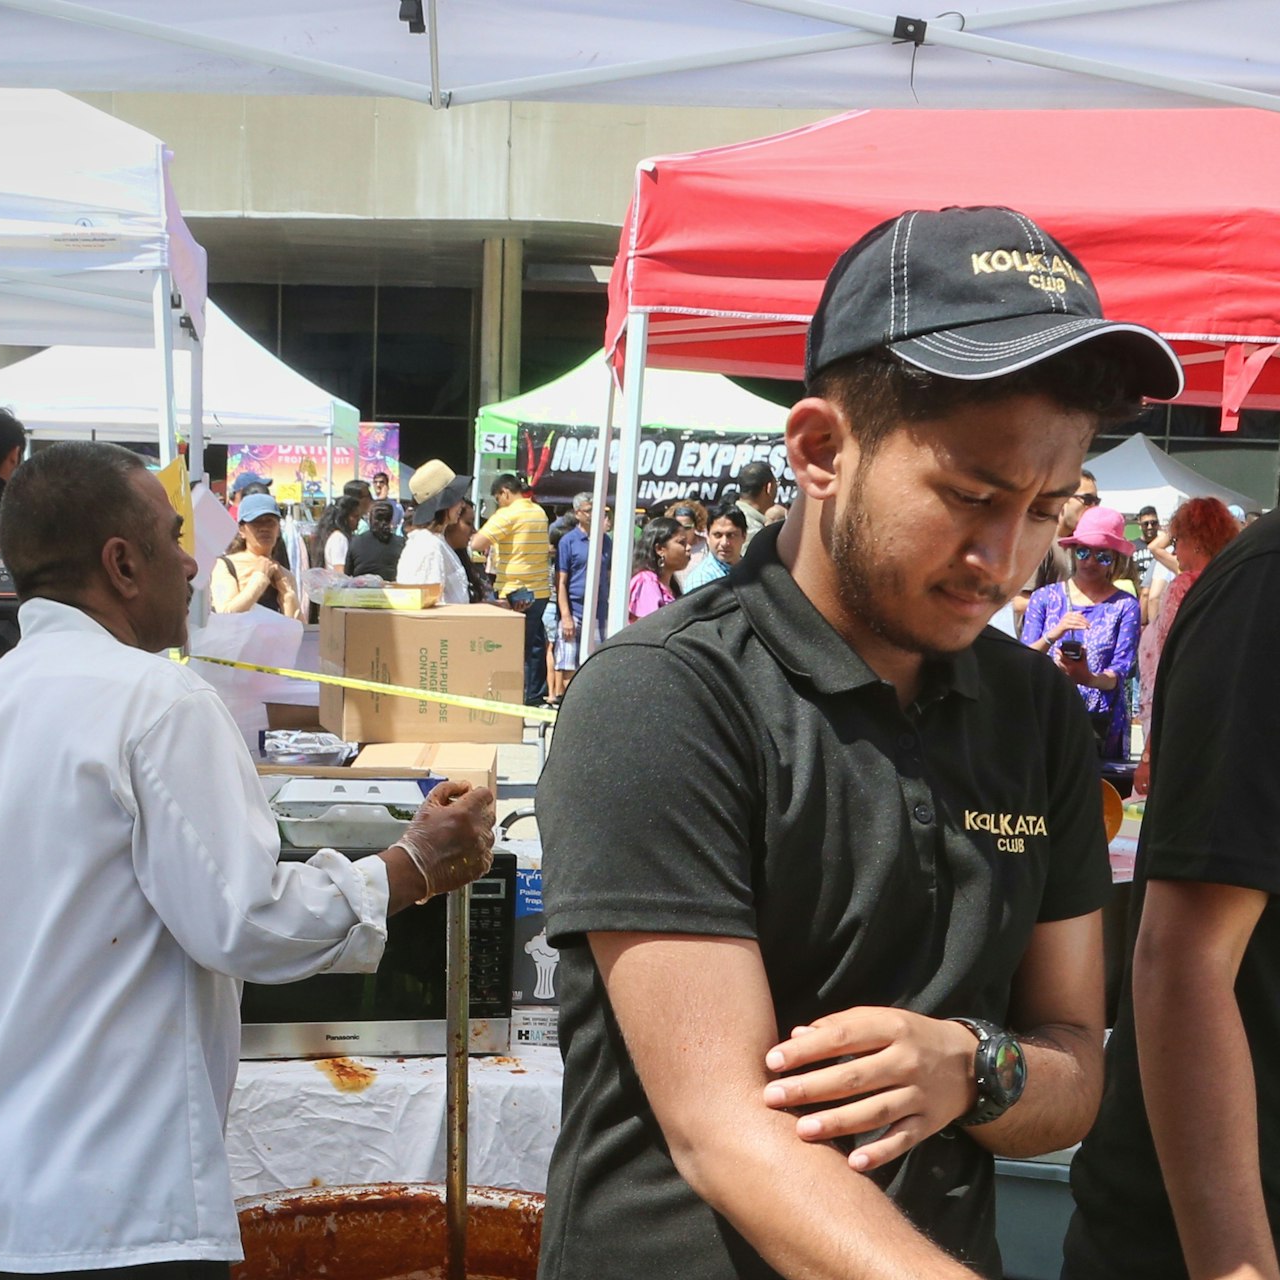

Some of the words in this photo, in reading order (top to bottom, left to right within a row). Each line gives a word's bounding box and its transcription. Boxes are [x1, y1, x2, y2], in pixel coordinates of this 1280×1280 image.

[1028, 274, 1066, 294] CLUB
[483, 434, 508, 453] 54
[321, 456, 351, 465] FUIT
[638, 479, 719, 501] INDIAN
[419, 647, 429, 715] CONTAINRS
[439, 639, 449, 723] MULTI-PUROSE
[964, 809, 1048, 837] KOLKATA
[996, 837, 1026, 854] CLUB
